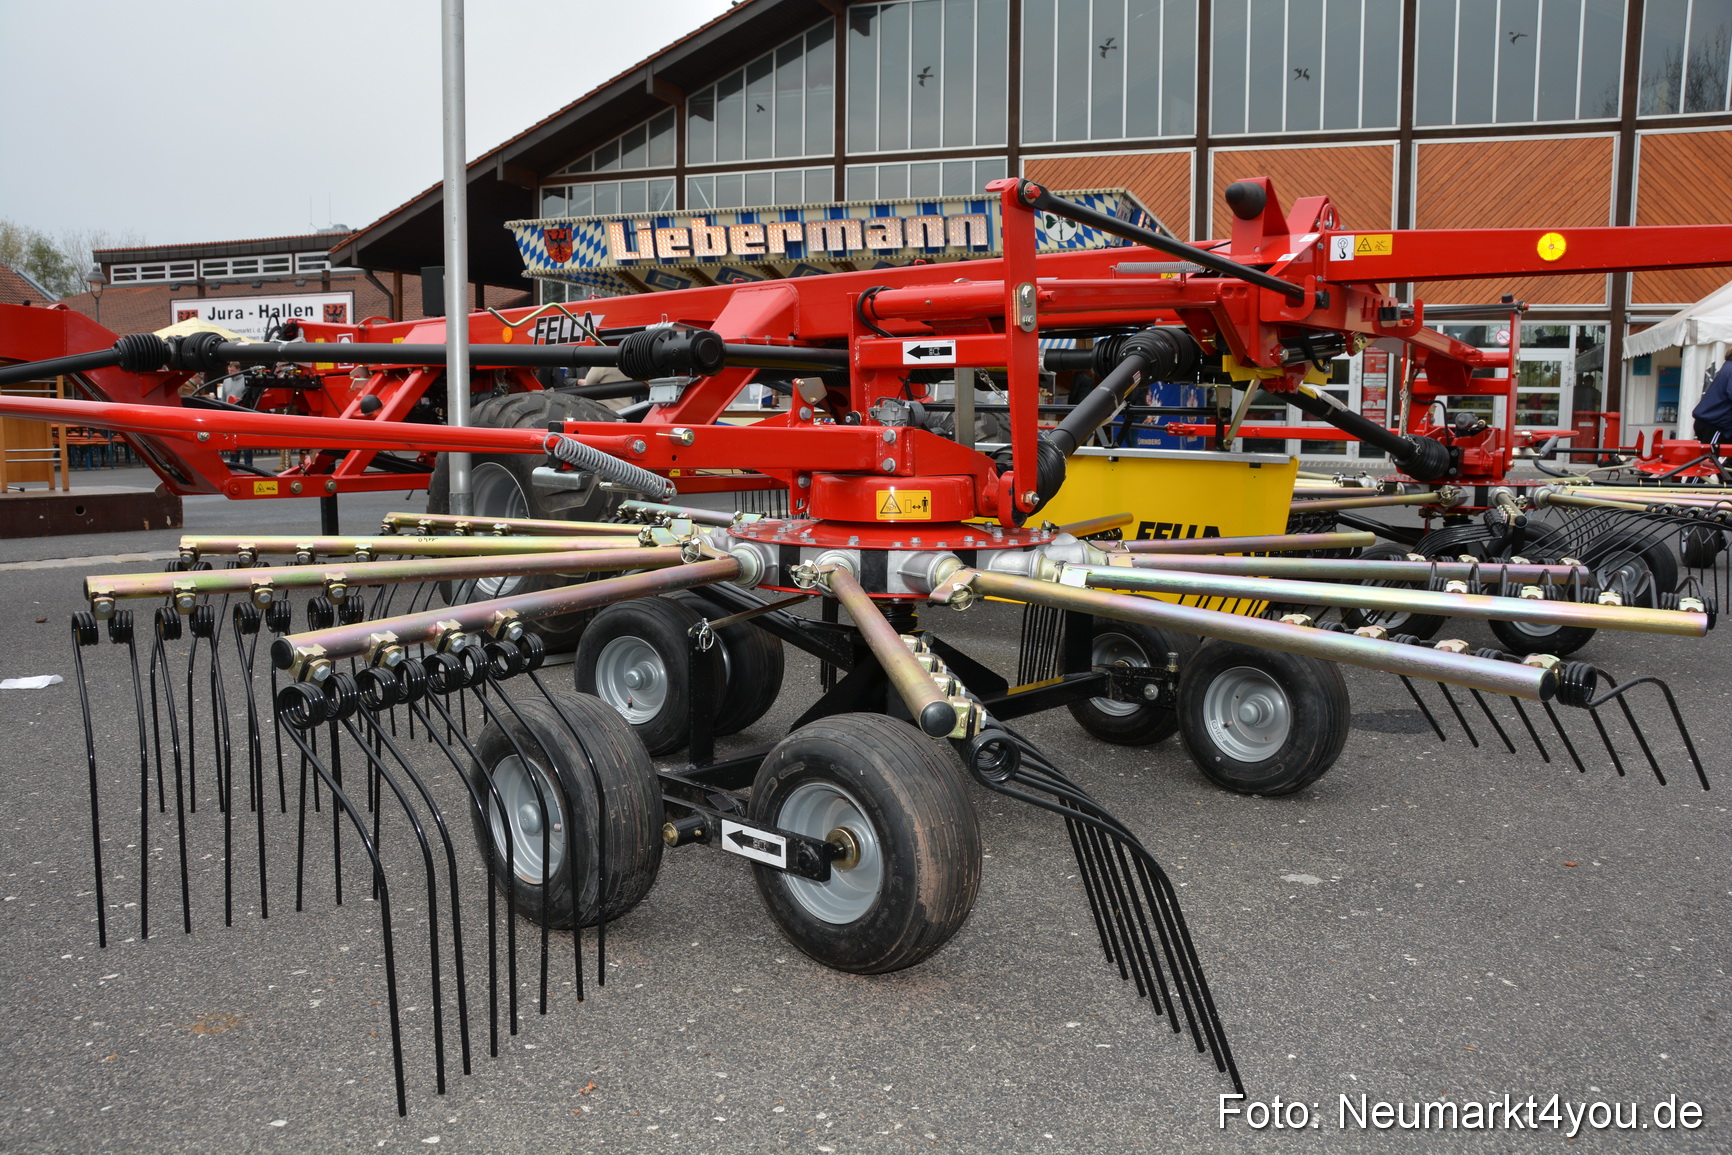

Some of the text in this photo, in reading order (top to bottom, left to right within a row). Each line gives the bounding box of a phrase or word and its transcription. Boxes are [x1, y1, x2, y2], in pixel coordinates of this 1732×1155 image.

[607, 212, 988, 261] Liebermann
[207, 307, 244, 320] Jura
[259, 303, 314, 318] Hallen
[533, 310, 598, 345] FELLA
